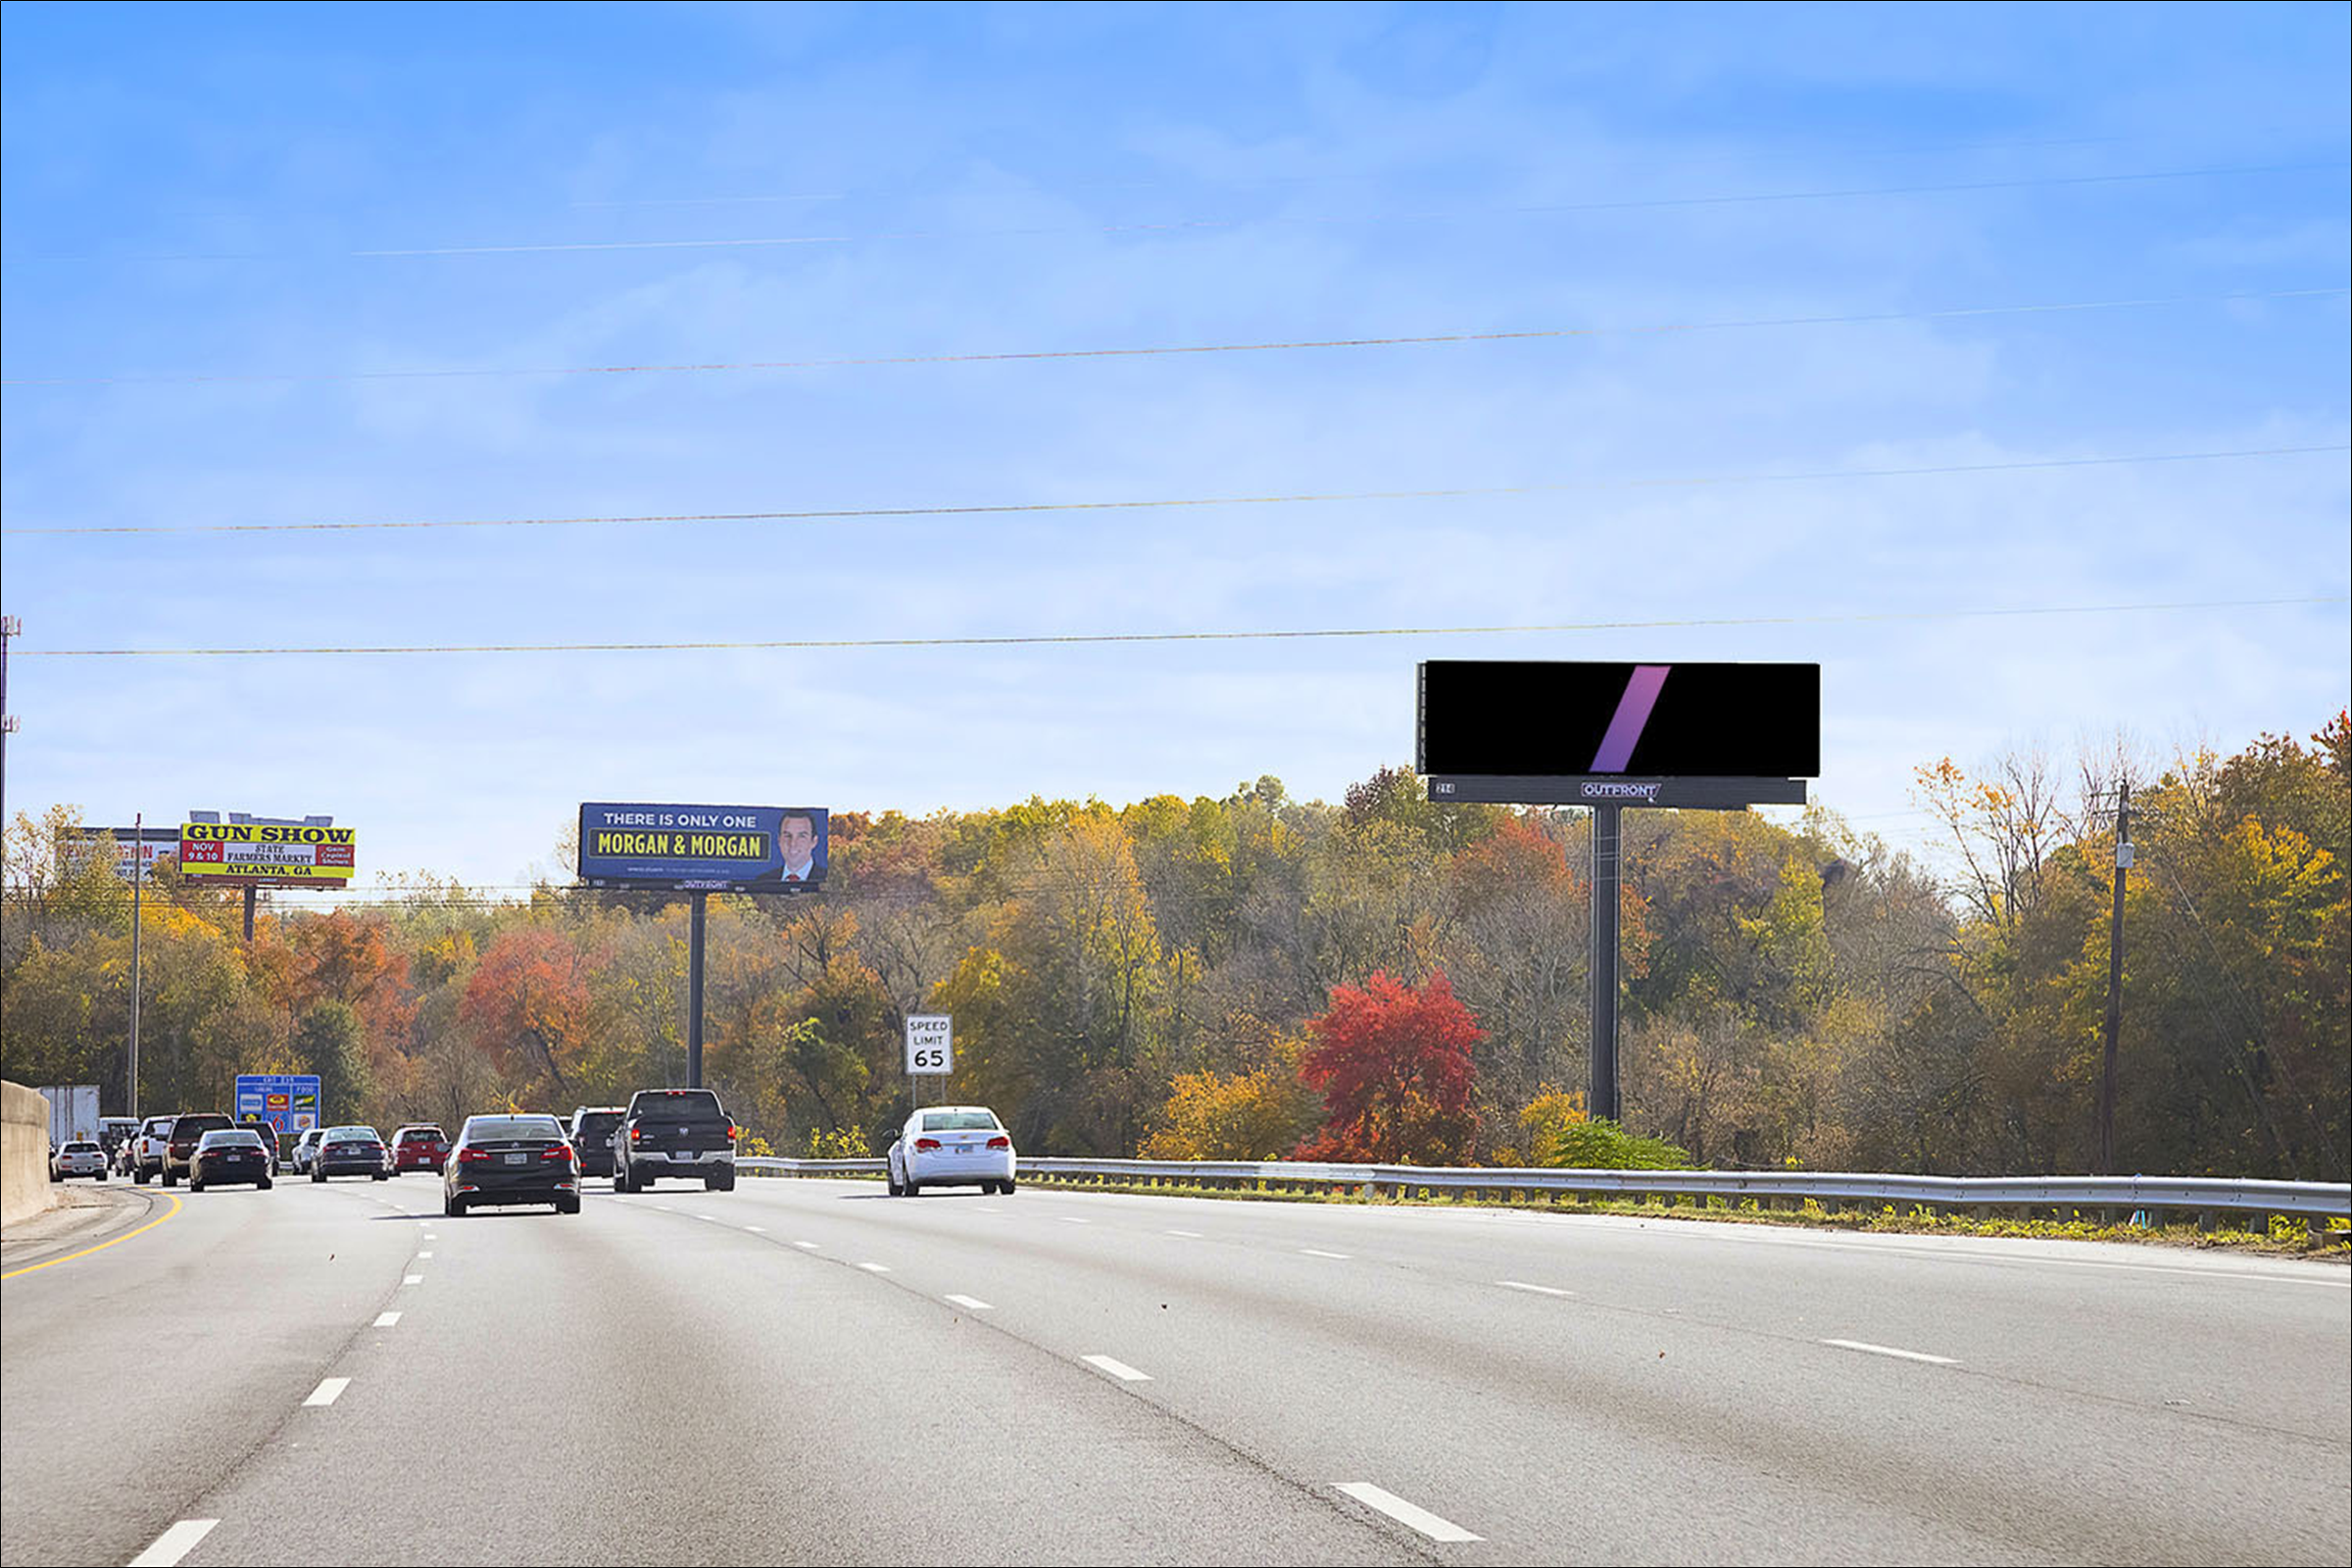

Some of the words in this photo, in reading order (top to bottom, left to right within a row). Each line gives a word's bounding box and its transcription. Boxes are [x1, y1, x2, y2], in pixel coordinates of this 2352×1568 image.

[1585, 784, 1656, 796] OUTFRONT
[604, 812, 656, 825] THERE
[659, 814, 673, 825] IS
[677, 814, 718, 826] ONLY
[722, 815, 757, 828] ONE
[187, 825, 253, 841] GUN
[261, 826, 353, 843] SHOW
[192, 842, 215, 852] NOV
[255, 845, 285, 854] STATE
[598, 832, 668, 854] MORGAN
[673, 834, 686, 855] &
[691, 835, 760, 857] MORGAN
[188, 852, 194, 860] 9
[196, 852, 204, 861] &
[227, 853, 270, 862] FARMERS
[273, 855, 313, 864] MARKET
[225, 864, 290, 876] ATLANTA,
[910, 1021, 948, 1031] SPEED
[913, 1036, 943, 1046] LIMIT
[914, 1050, 944, 1067] 65
